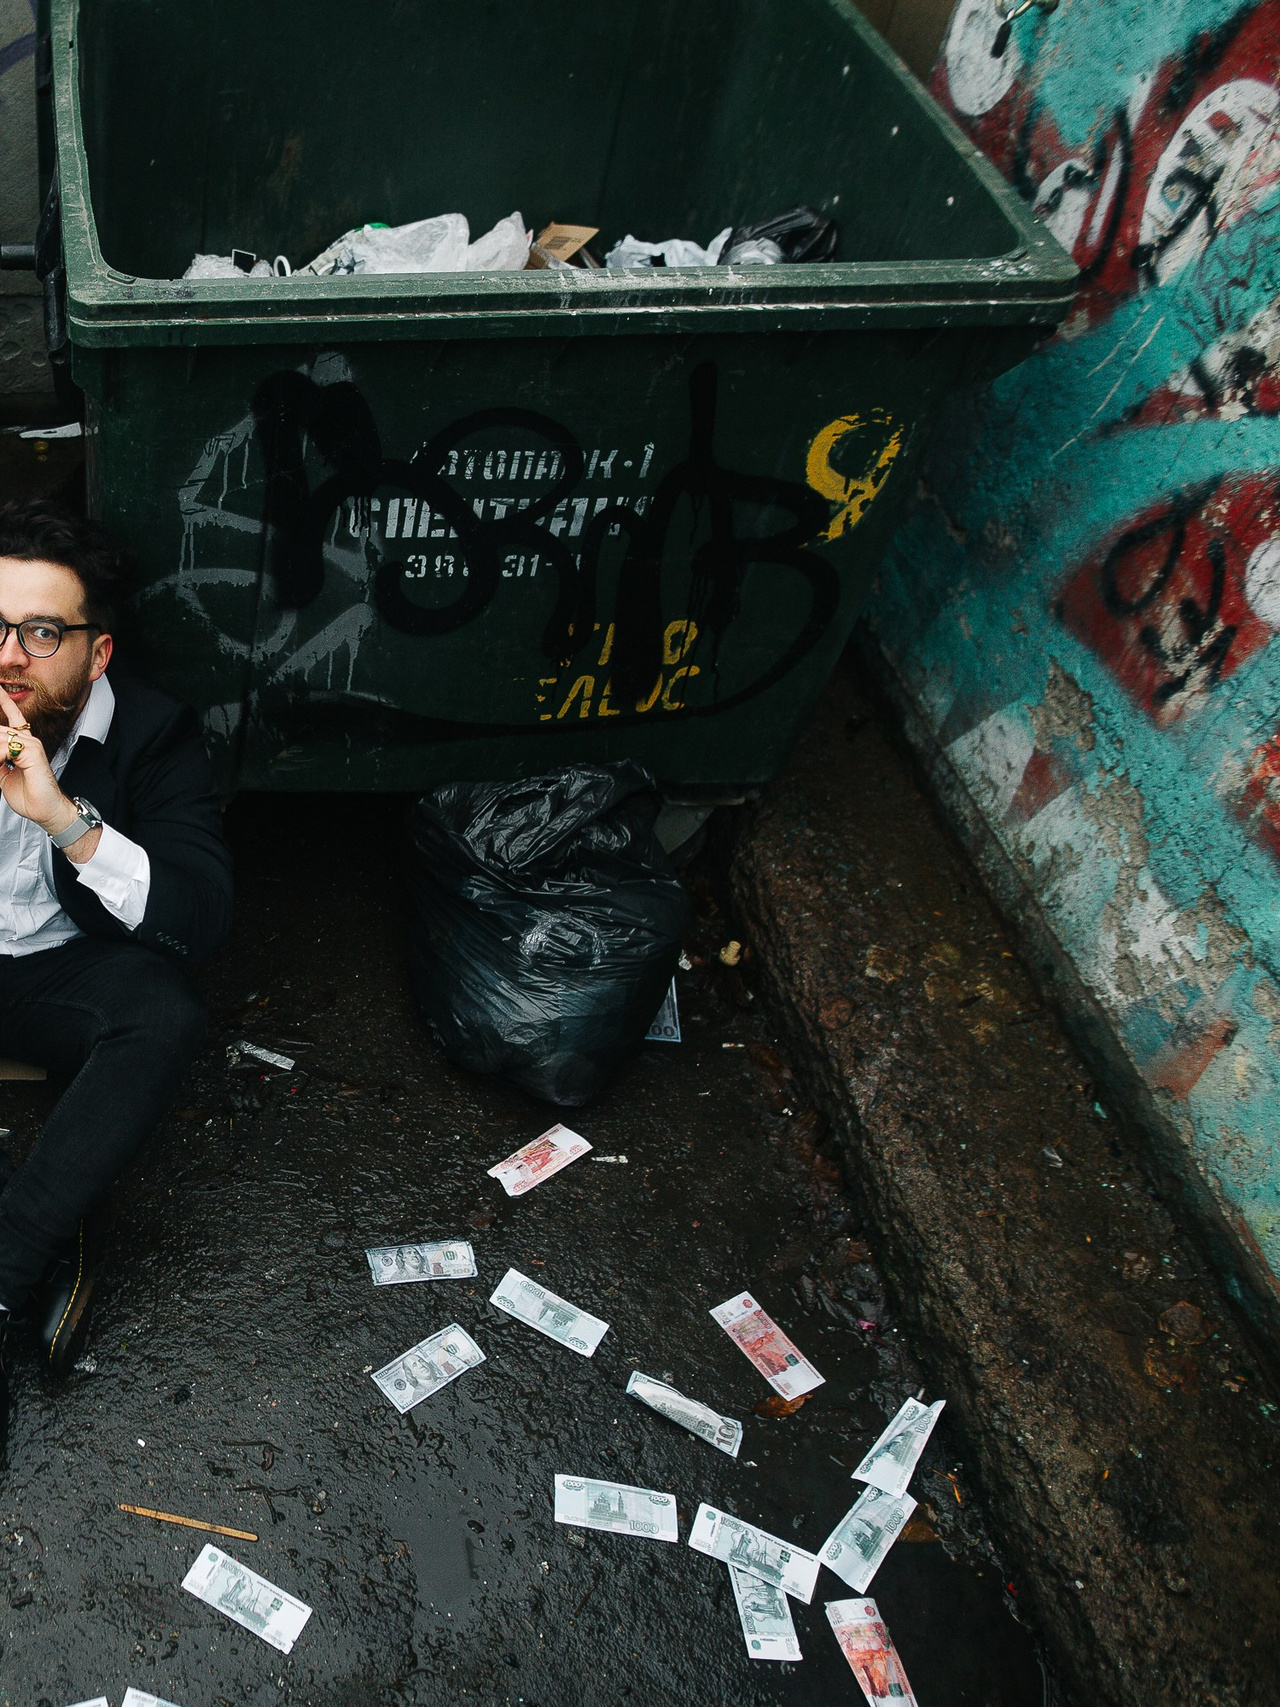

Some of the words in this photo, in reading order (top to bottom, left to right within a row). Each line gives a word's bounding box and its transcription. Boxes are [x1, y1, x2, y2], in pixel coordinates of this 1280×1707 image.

[520, 1280, 546, 1300] 1000
[904, 1404, 917, 1421] 1000
[915, 1409, 934, 1434] 1000
[564, 1480, 582, 1488] 1000
[650, 1494, 669, 1503] 1000
[868, 1487, 879, 1502] 1000
[629, 1519, 659, 1535] 1000
[885, 1507, 905, 1535] 1000
[826, 1542, 840, 1561] 1000
